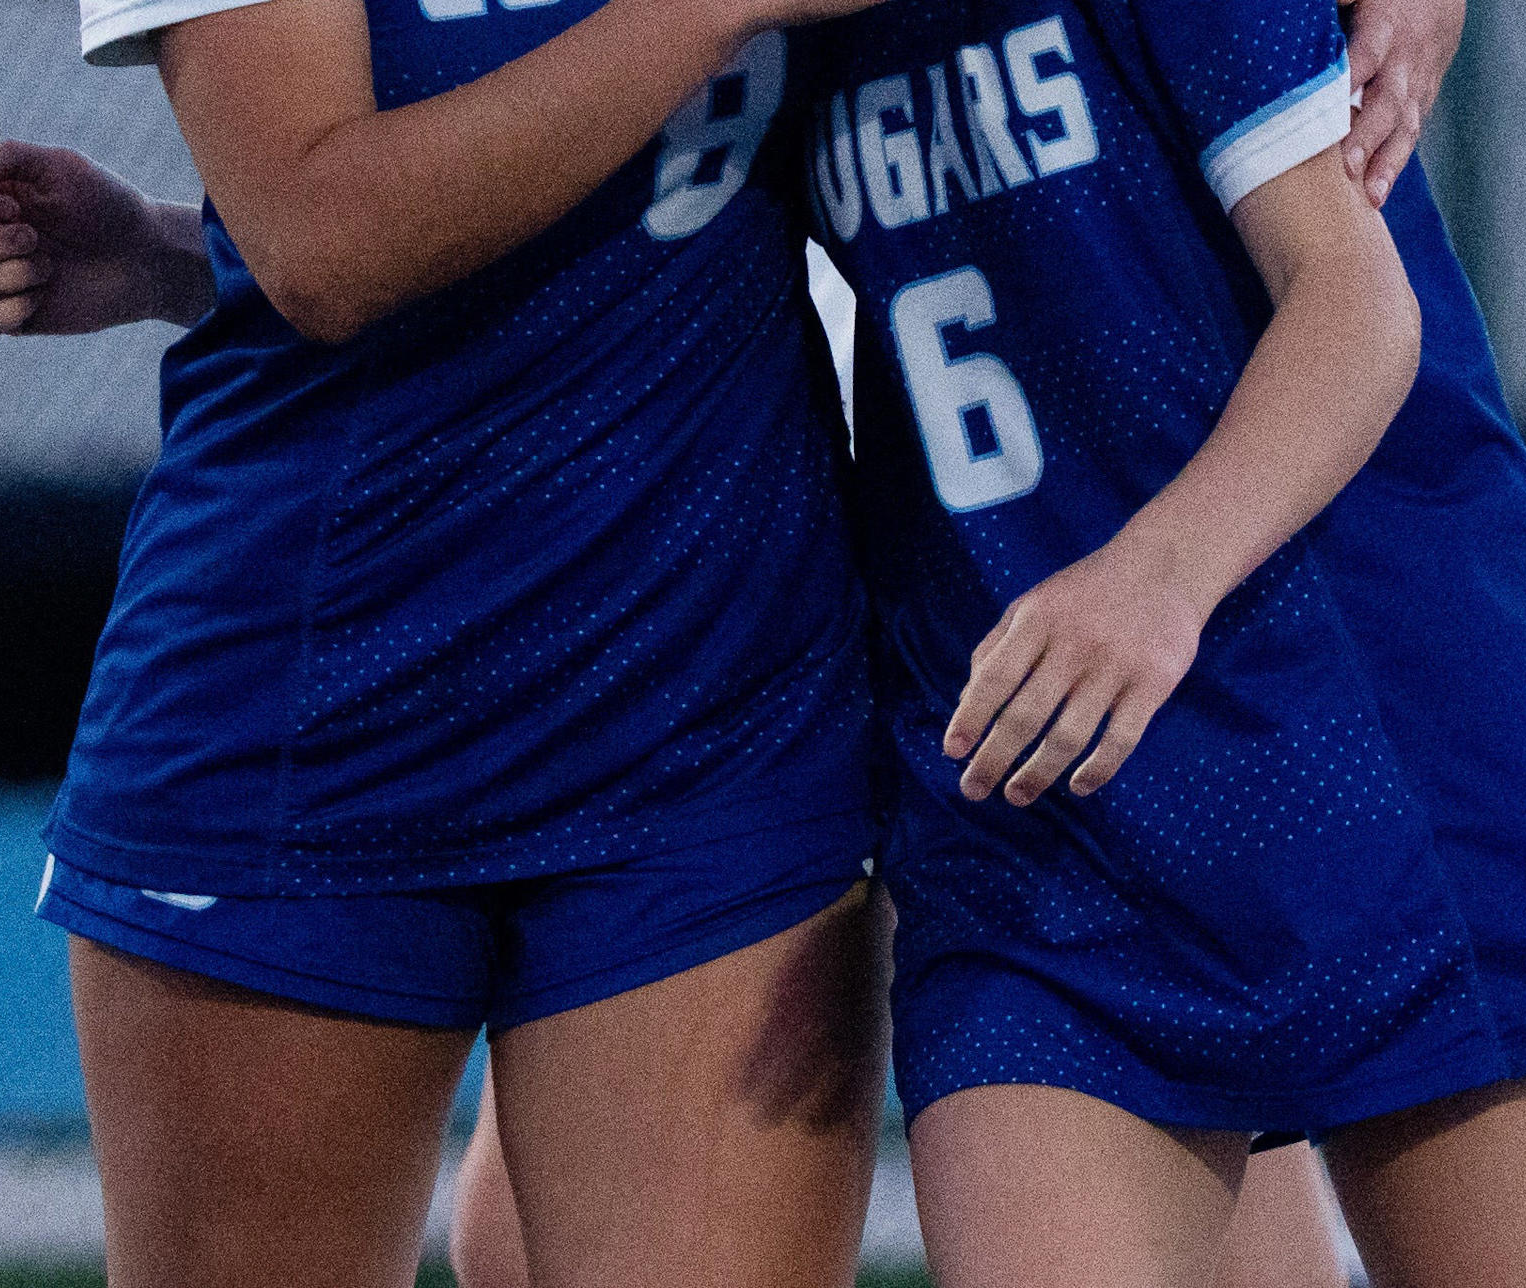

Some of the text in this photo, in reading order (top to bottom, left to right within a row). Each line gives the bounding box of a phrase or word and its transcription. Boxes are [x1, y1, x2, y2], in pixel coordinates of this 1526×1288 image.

[640, 28, 790, 243] 8
[807, 14, 1100, 245] UGARS
[887, 263, 1045, 514] 6
